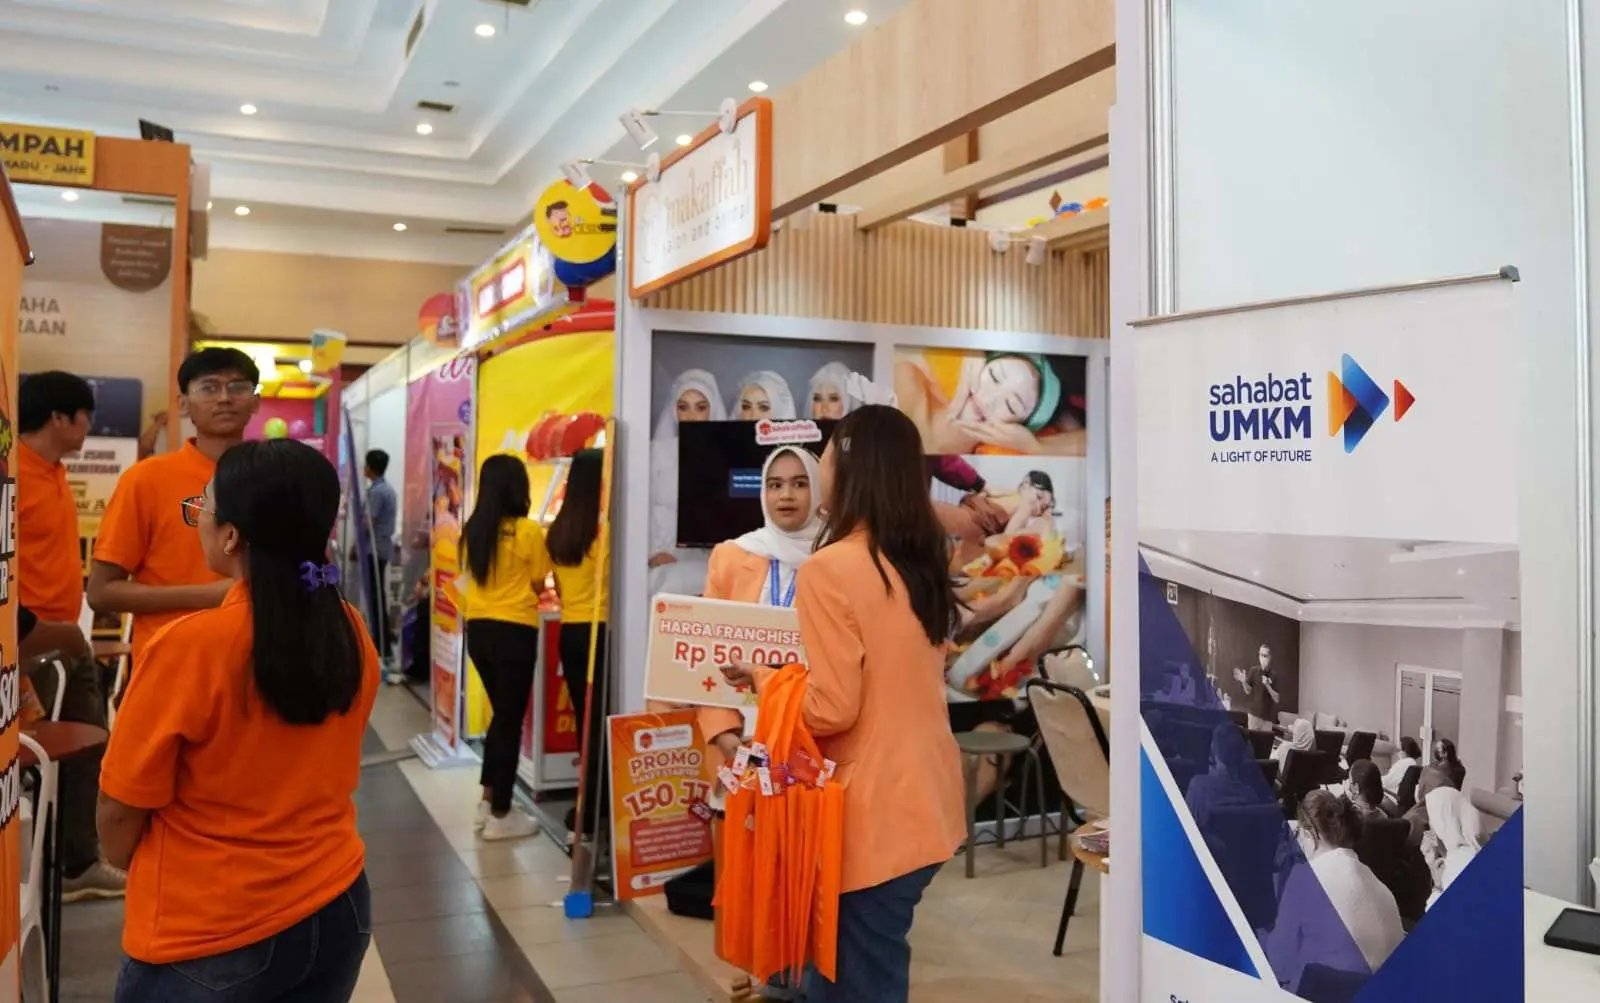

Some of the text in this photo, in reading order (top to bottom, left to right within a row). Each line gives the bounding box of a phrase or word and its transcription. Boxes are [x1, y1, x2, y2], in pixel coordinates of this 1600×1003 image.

[1209, 372, 1312, 405] sahabat
[1209, 405, 1312, 442] UMKM
[1211, 449, 1312, 463] A LIGHT OF FUTURE
[659, 618, 800, 646] HARGA FRANCHISE
[674, 640, 799, 669] Rp 50000
[631, 751, 700, 773] PROMO
[626, 782, 674, 817] 150
